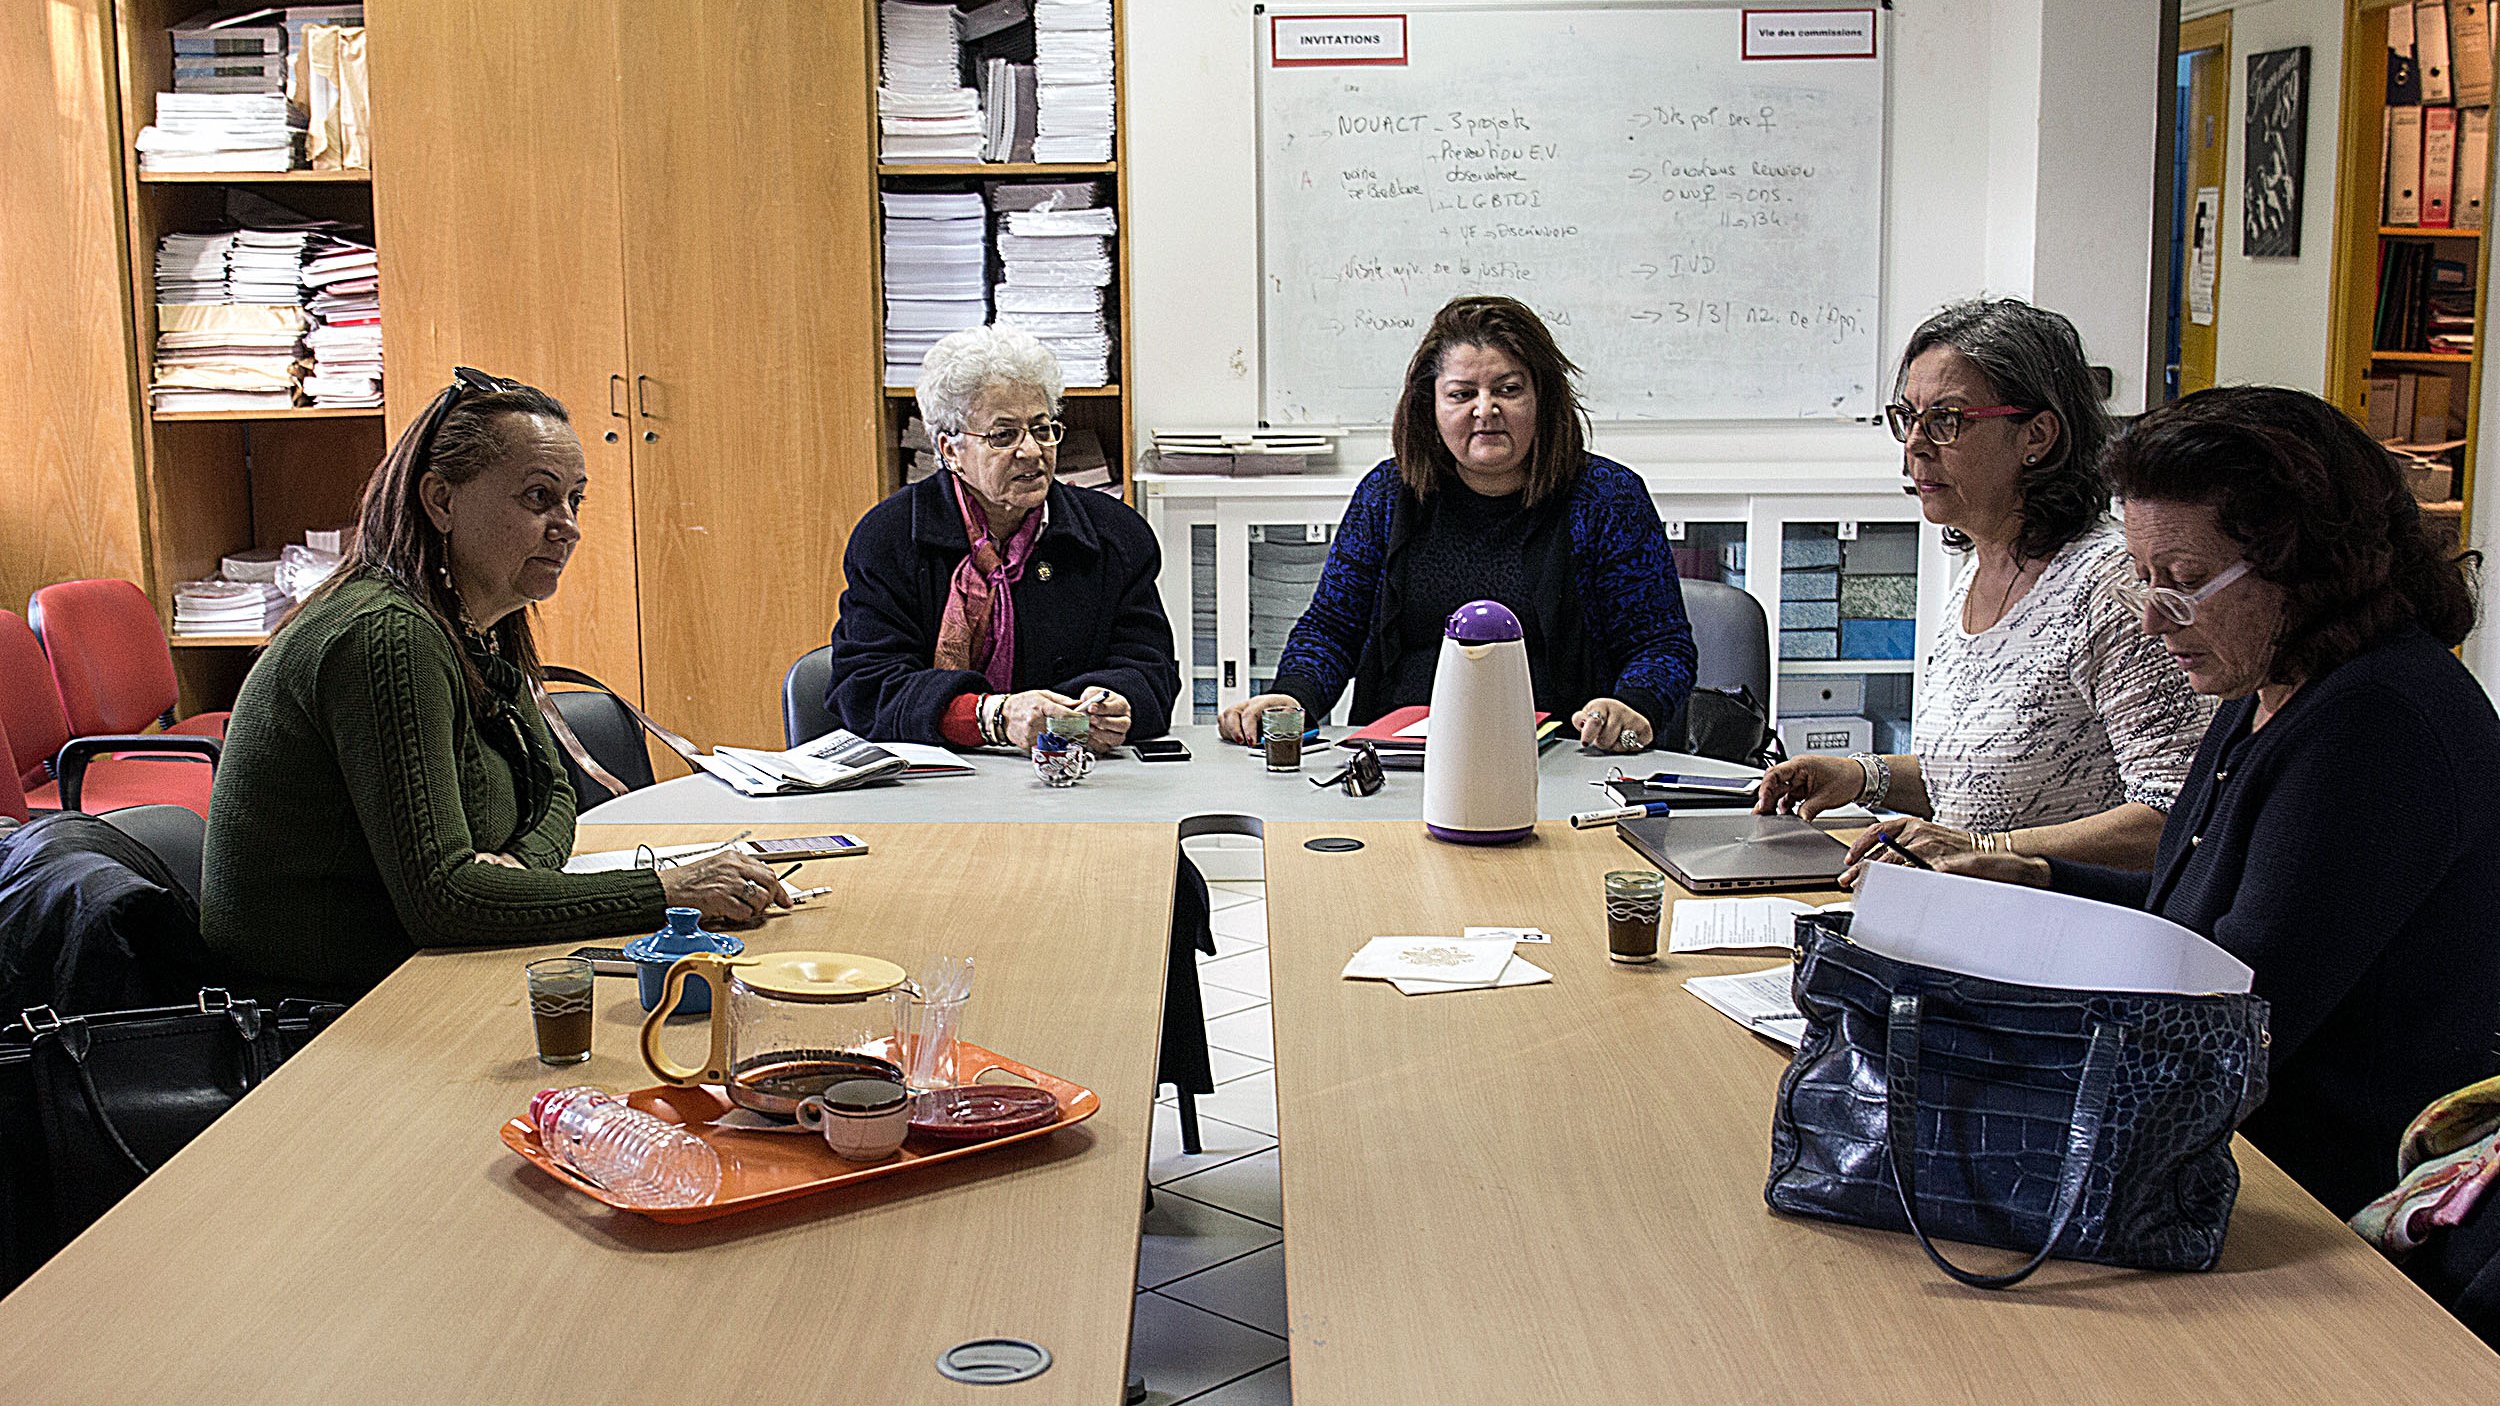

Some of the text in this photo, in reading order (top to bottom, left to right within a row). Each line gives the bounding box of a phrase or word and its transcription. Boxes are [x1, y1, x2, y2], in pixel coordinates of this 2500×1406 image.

[1758, 29, 1863, 37] Vie des commissions
[1300, 35, 1381, 45] INVITATIONS
